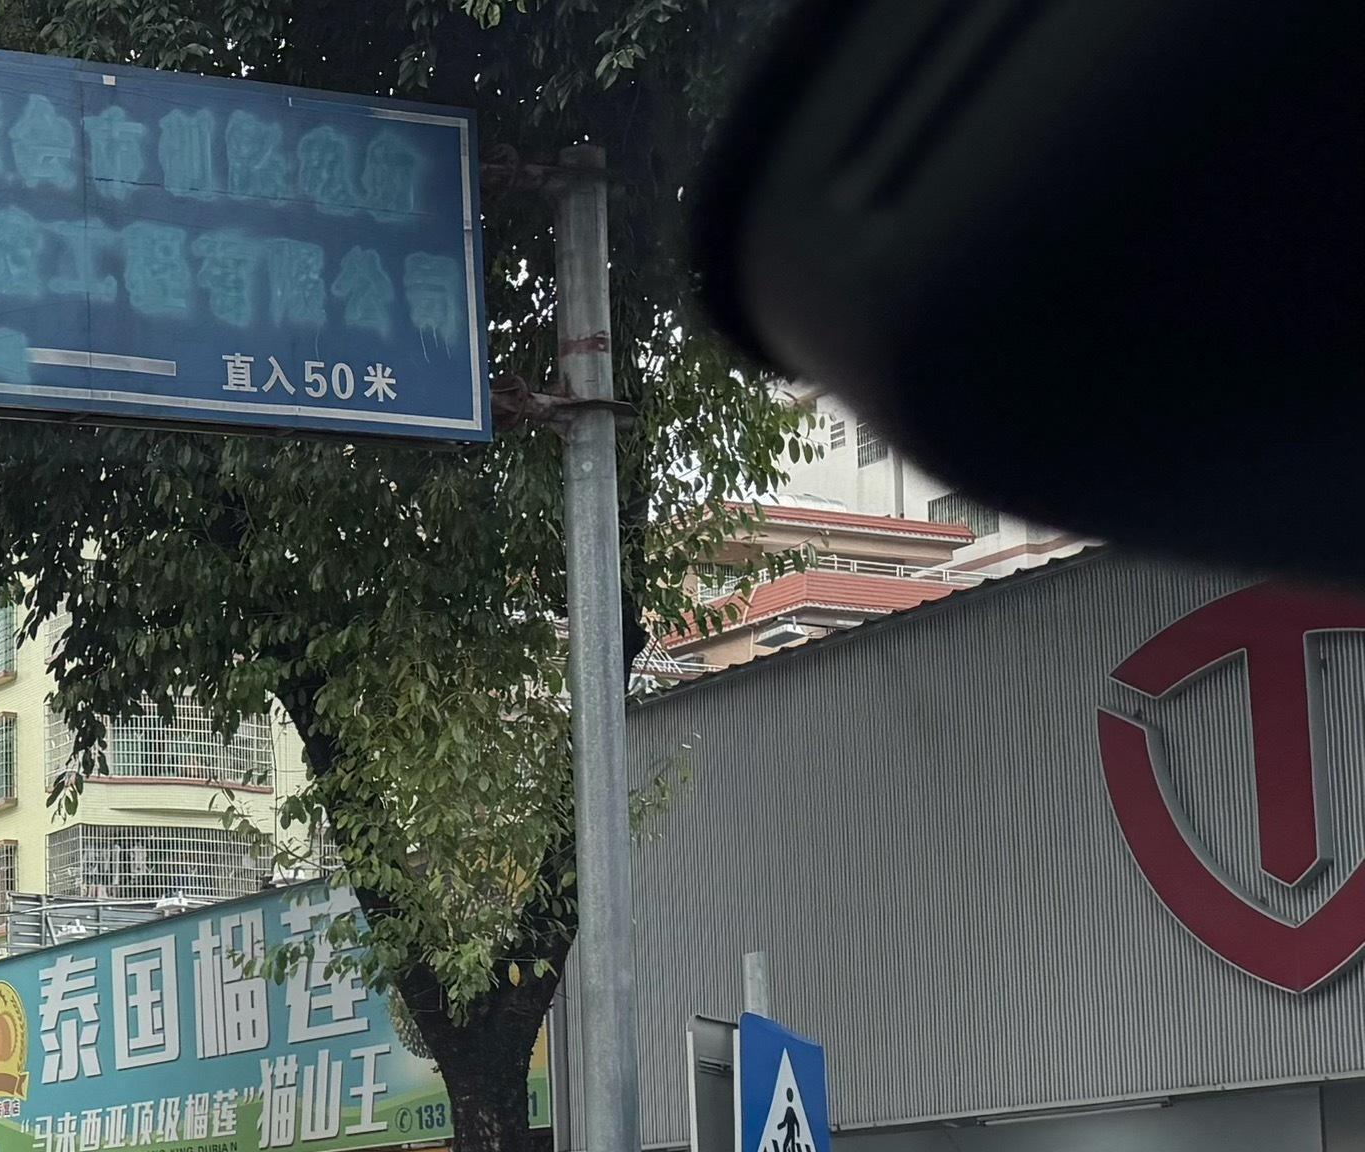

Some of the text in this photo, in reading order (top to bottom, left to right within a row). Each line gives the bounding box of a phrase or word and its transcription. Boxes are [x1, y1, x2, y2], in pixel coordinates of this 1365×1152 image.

[221, 353, 397, 403] 直入50米
[38, 886, 371, 1086] 泰国榴莲
[257, 1043, 391, 1150] 猫山王
